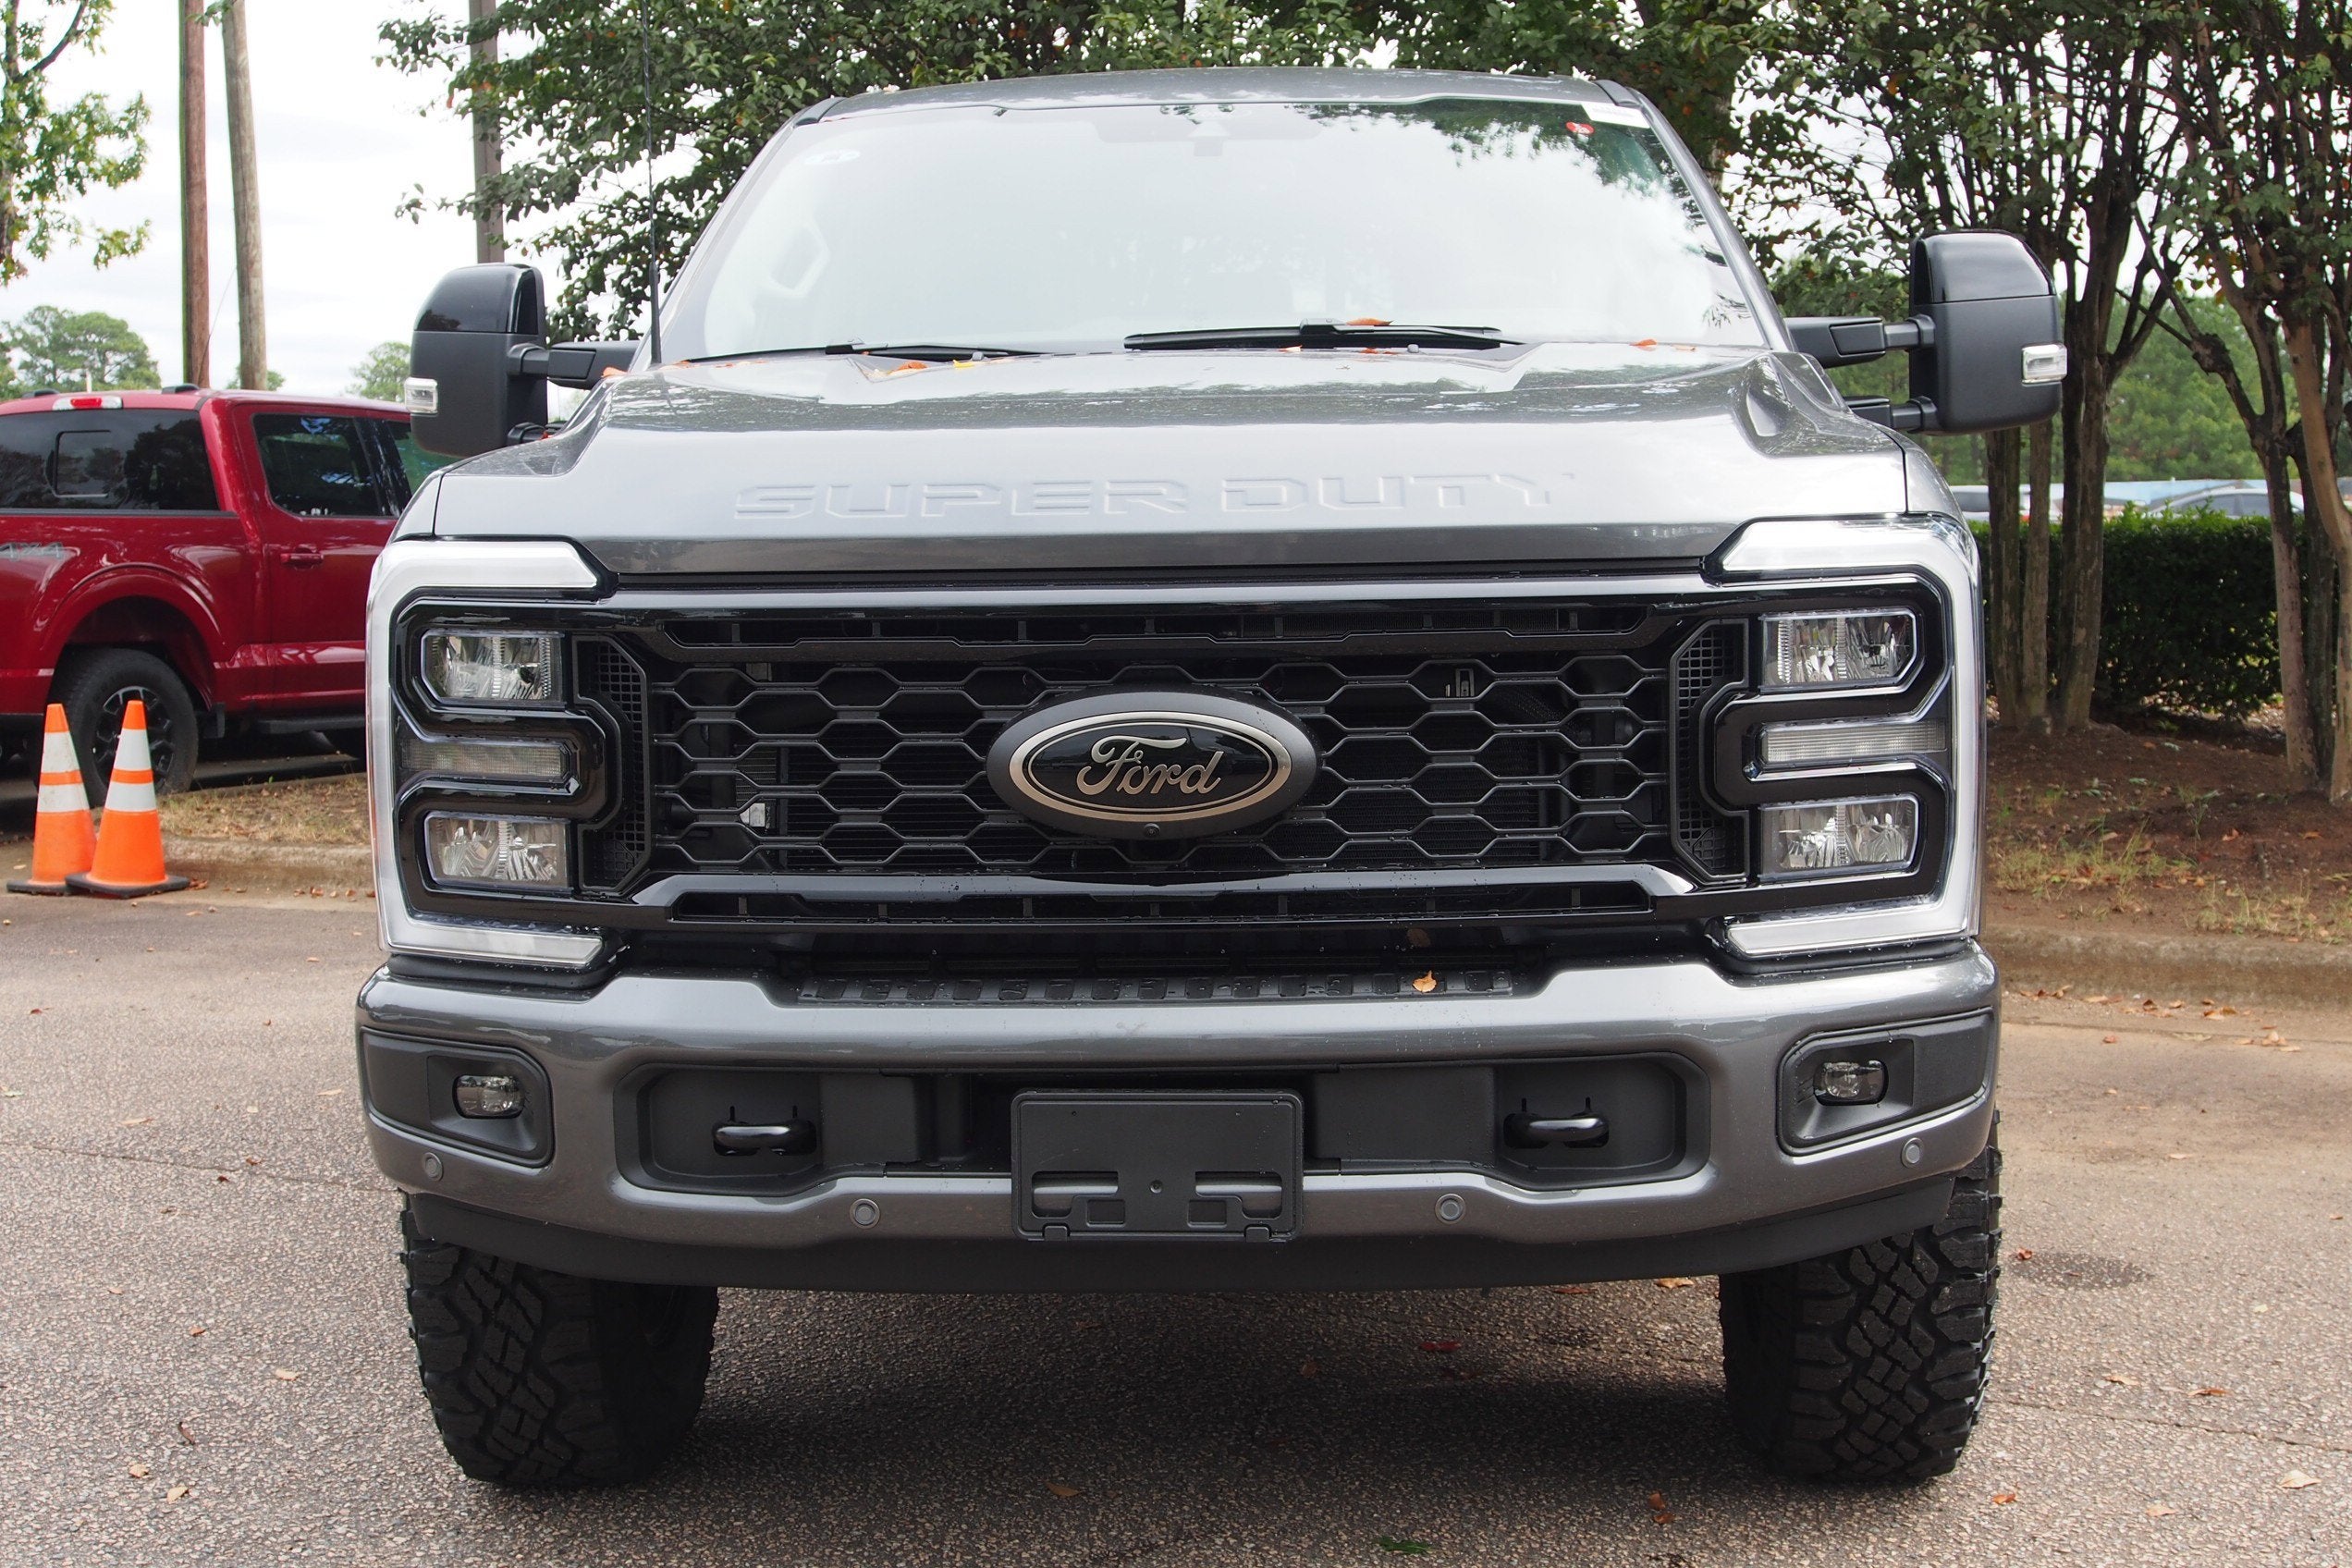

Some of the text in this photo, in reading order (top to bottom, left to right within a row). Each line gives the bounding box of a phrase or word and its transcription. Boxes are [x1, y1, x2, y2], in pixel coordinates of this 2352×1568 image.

[734, 472, 1575, 520] SUPER DUTY
[1076, 735, 1225, 795] Ford
